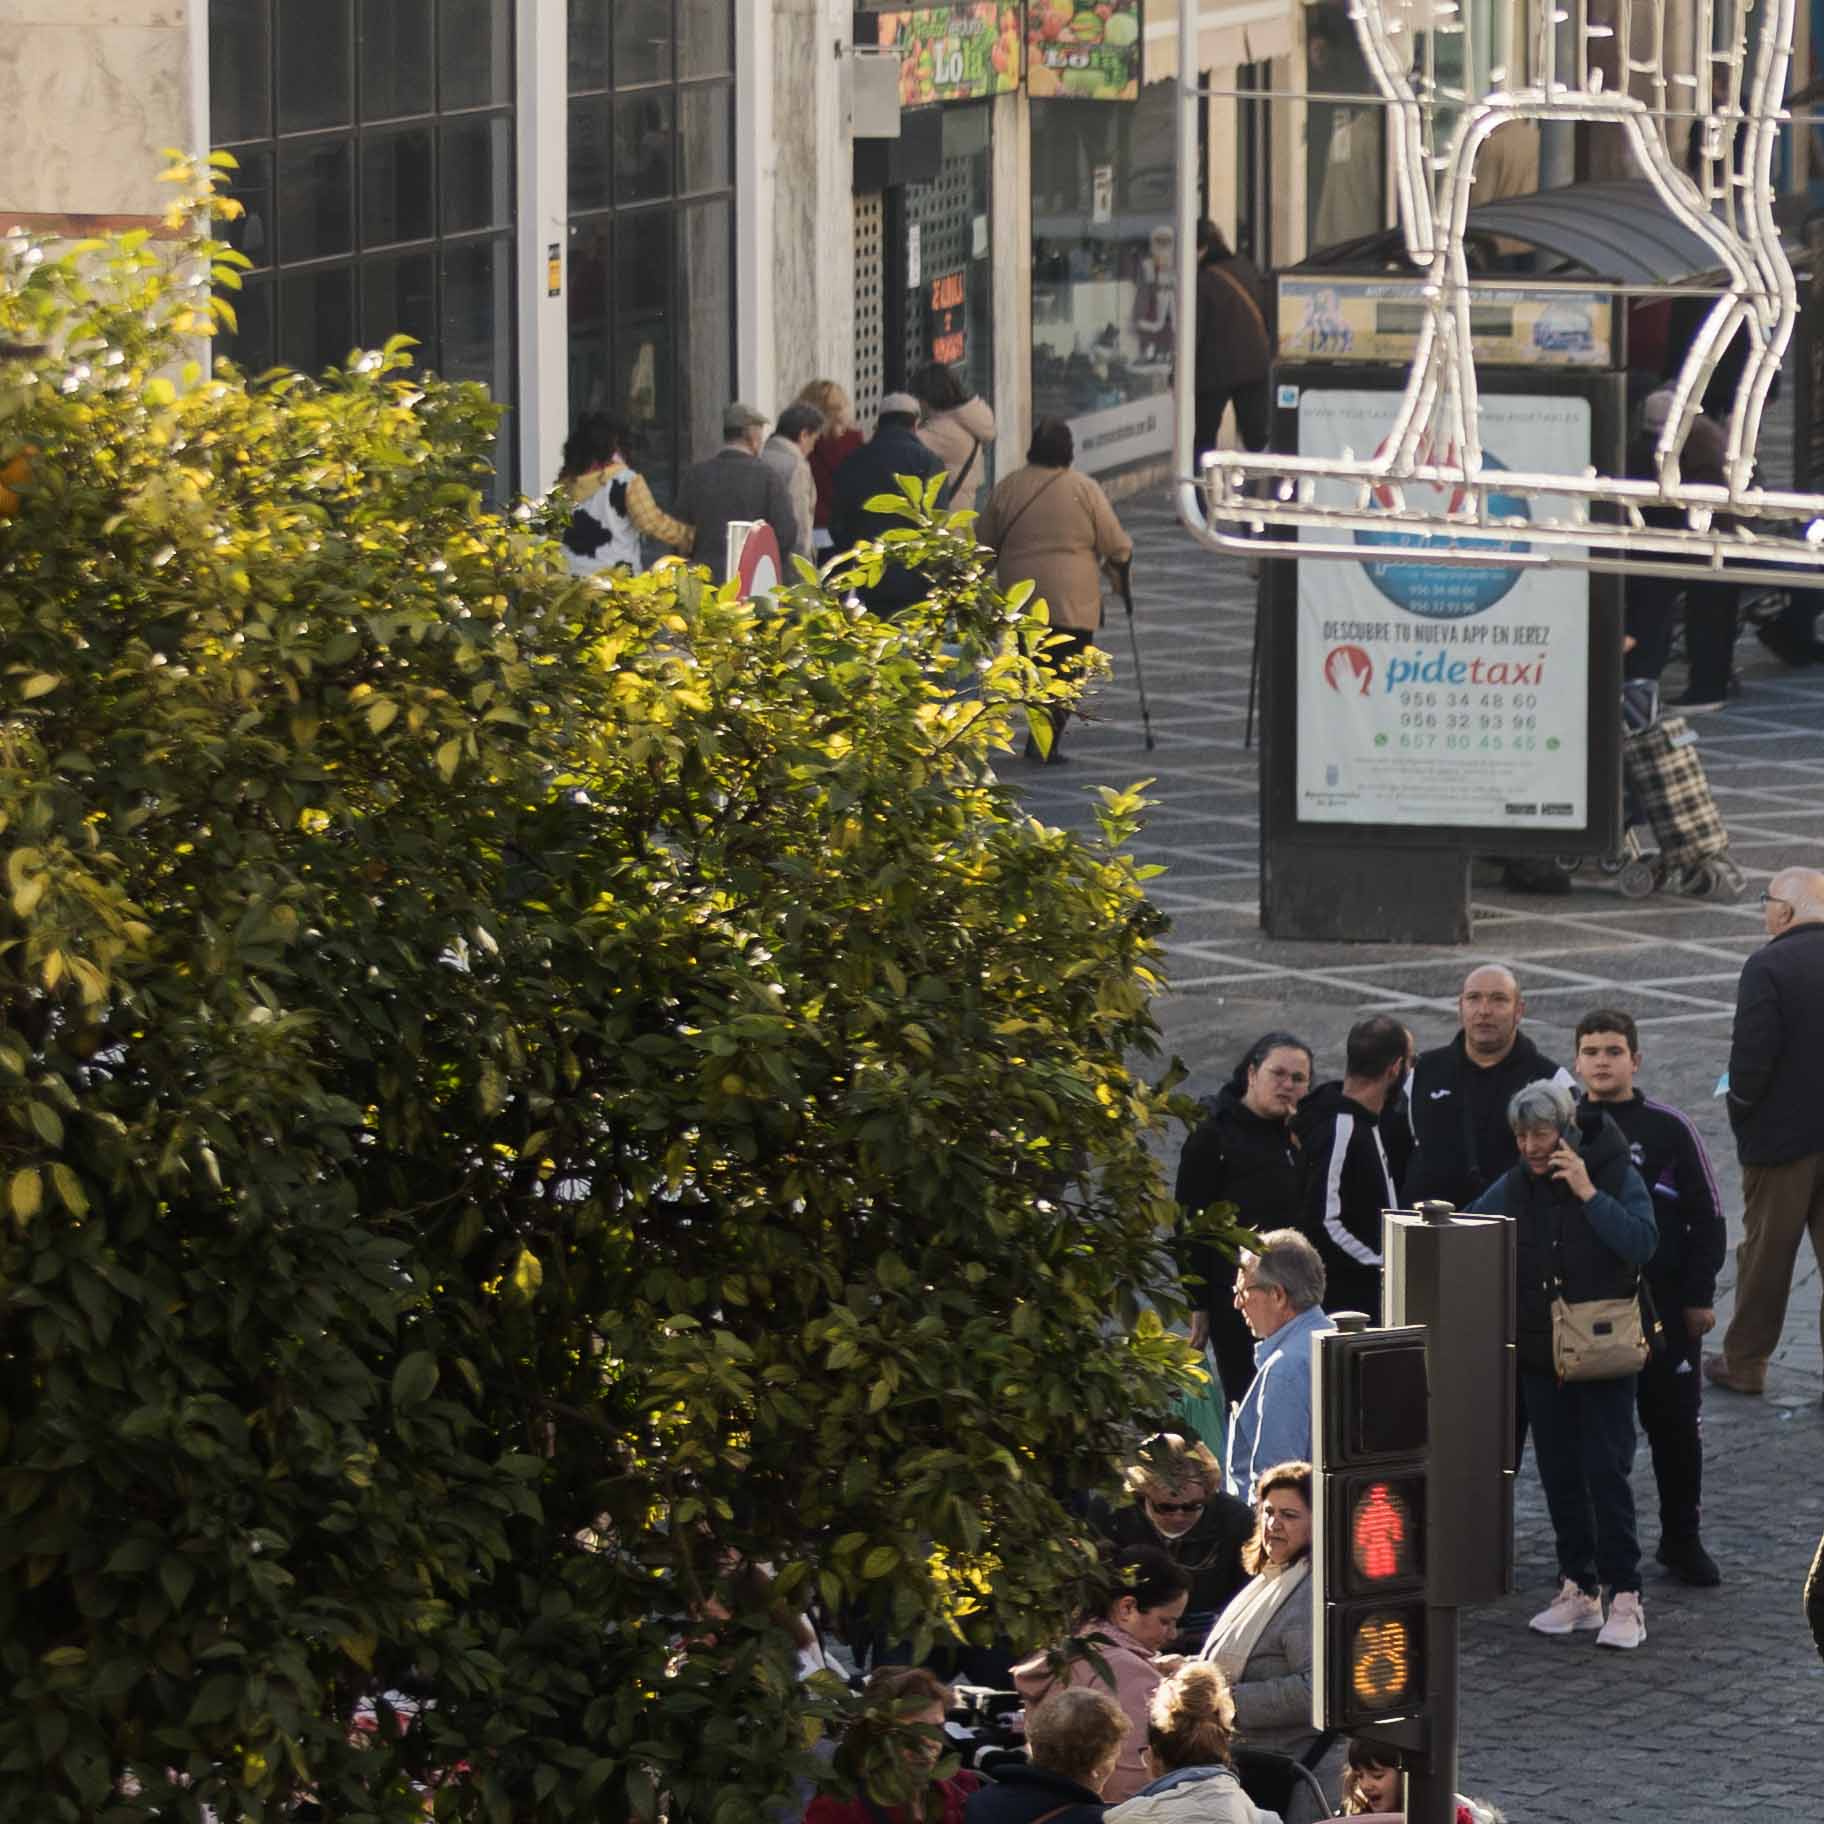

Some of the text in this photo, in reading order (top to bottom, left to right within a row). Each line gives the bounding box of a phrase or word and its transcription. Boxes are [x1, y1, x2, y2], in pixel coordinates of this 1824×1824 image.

[1323, 621, 1551, 646] DESCUBRE TU NUEVA APP EN JEREZ
[1386, 650, 1548, 694] pidetaxi
[1400, 692, 1537, 709] 956 34 48 60
